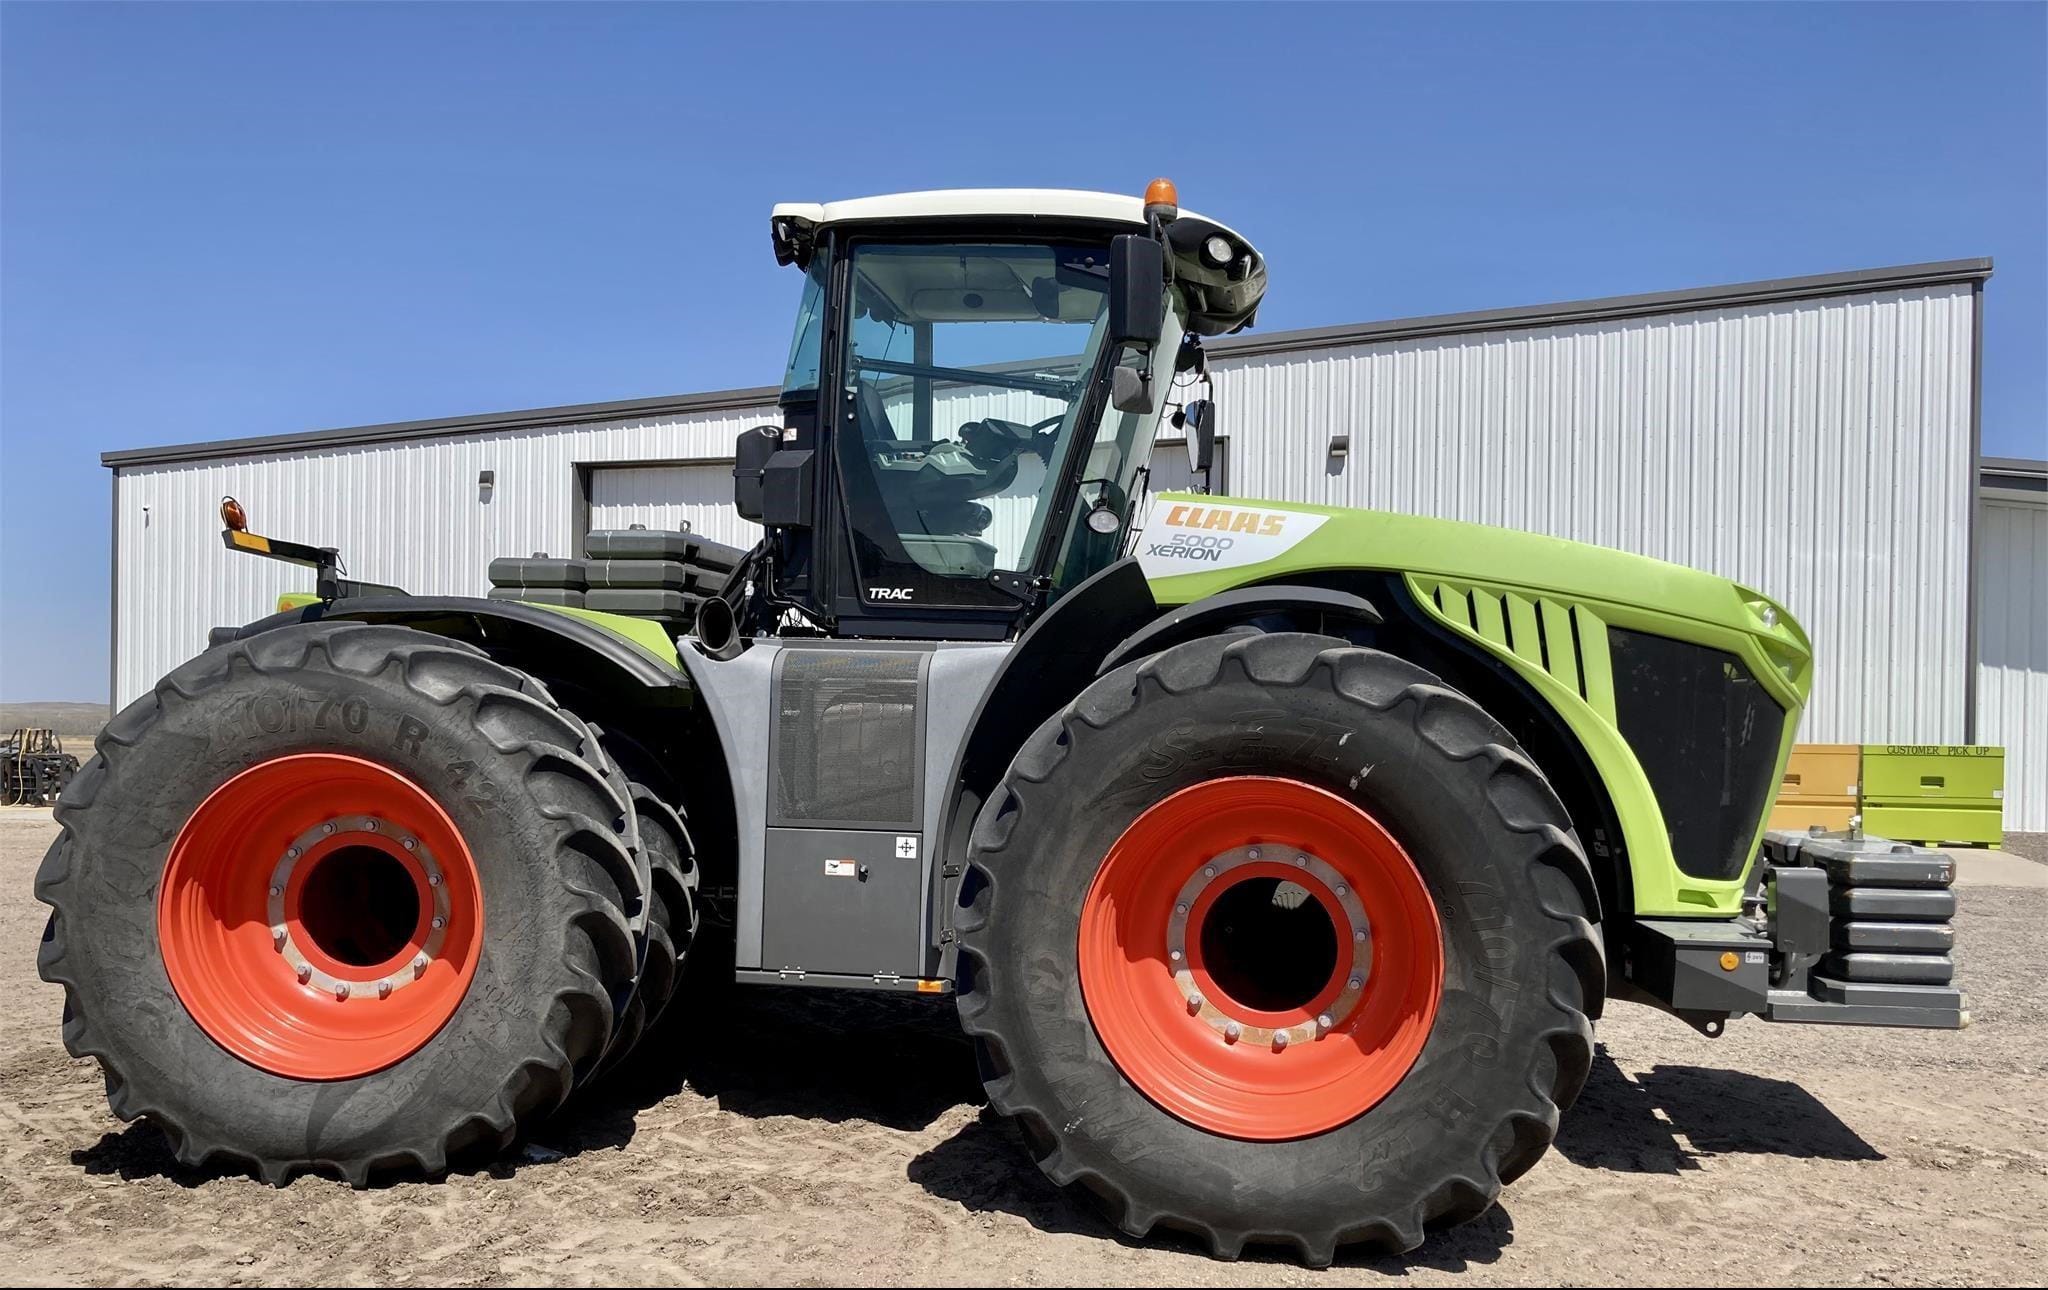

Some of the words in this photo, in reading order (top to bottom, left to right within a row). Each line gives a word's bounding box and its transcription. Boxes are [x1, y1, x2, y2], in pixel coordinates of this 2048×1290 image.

[1165, 506, 1287, 536] CLAAS
[1170, 533, 1234, 550] 5000
[1146, 543, 1221, 561] XERION
[869, 587, 914, 600] TRAC
[393, 713, 430, 760] R
[1886, 745, 1940, 756] CUSTOMER
[1947, 746, 1969, 756] PICK
[1975, 746, 1990, 756] UP
